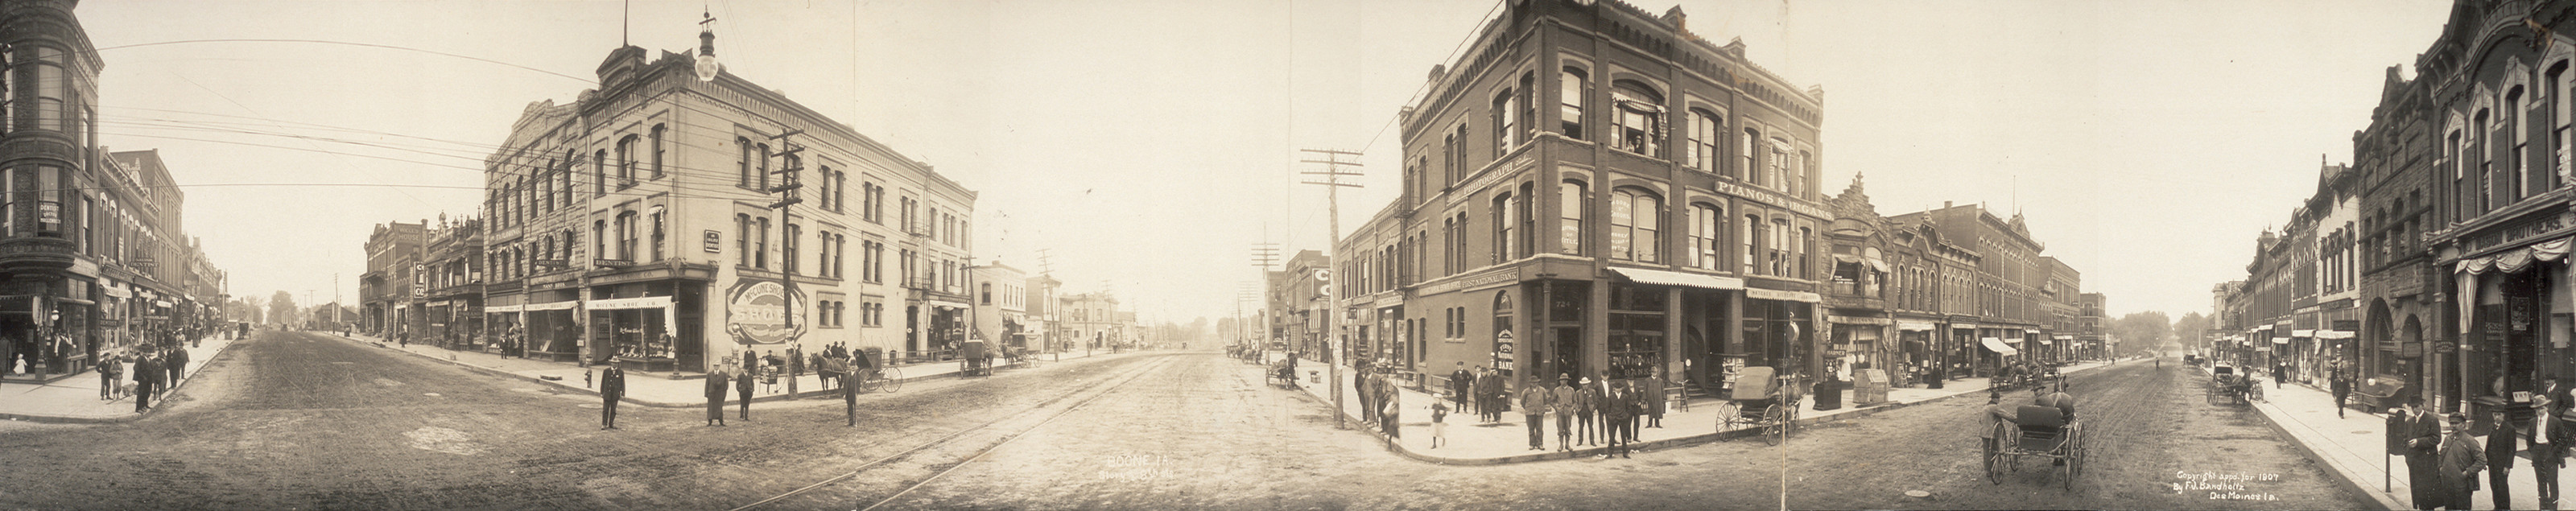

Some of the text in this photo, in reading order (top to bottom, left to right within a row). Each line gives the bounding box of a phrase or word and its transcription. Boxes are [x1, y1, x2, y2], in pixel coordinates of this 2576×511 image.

[1463, 161, 1513, 195] PHOTOGRAPH
[1717, 180, 1774, 204] PIANOS
[1777, 197, 1785, 207] &
[398, 233, 419, 241] HOUSE
[2506, 214, 2564, 242] BROTHERS.
[1475, 274, 1499, 285] NATIONAL
[1500, 271, 1517, 282] BANK
[745, 283, 784, 302] McCUNE SHOE
[1498, 361, 1513, 370] BANK
